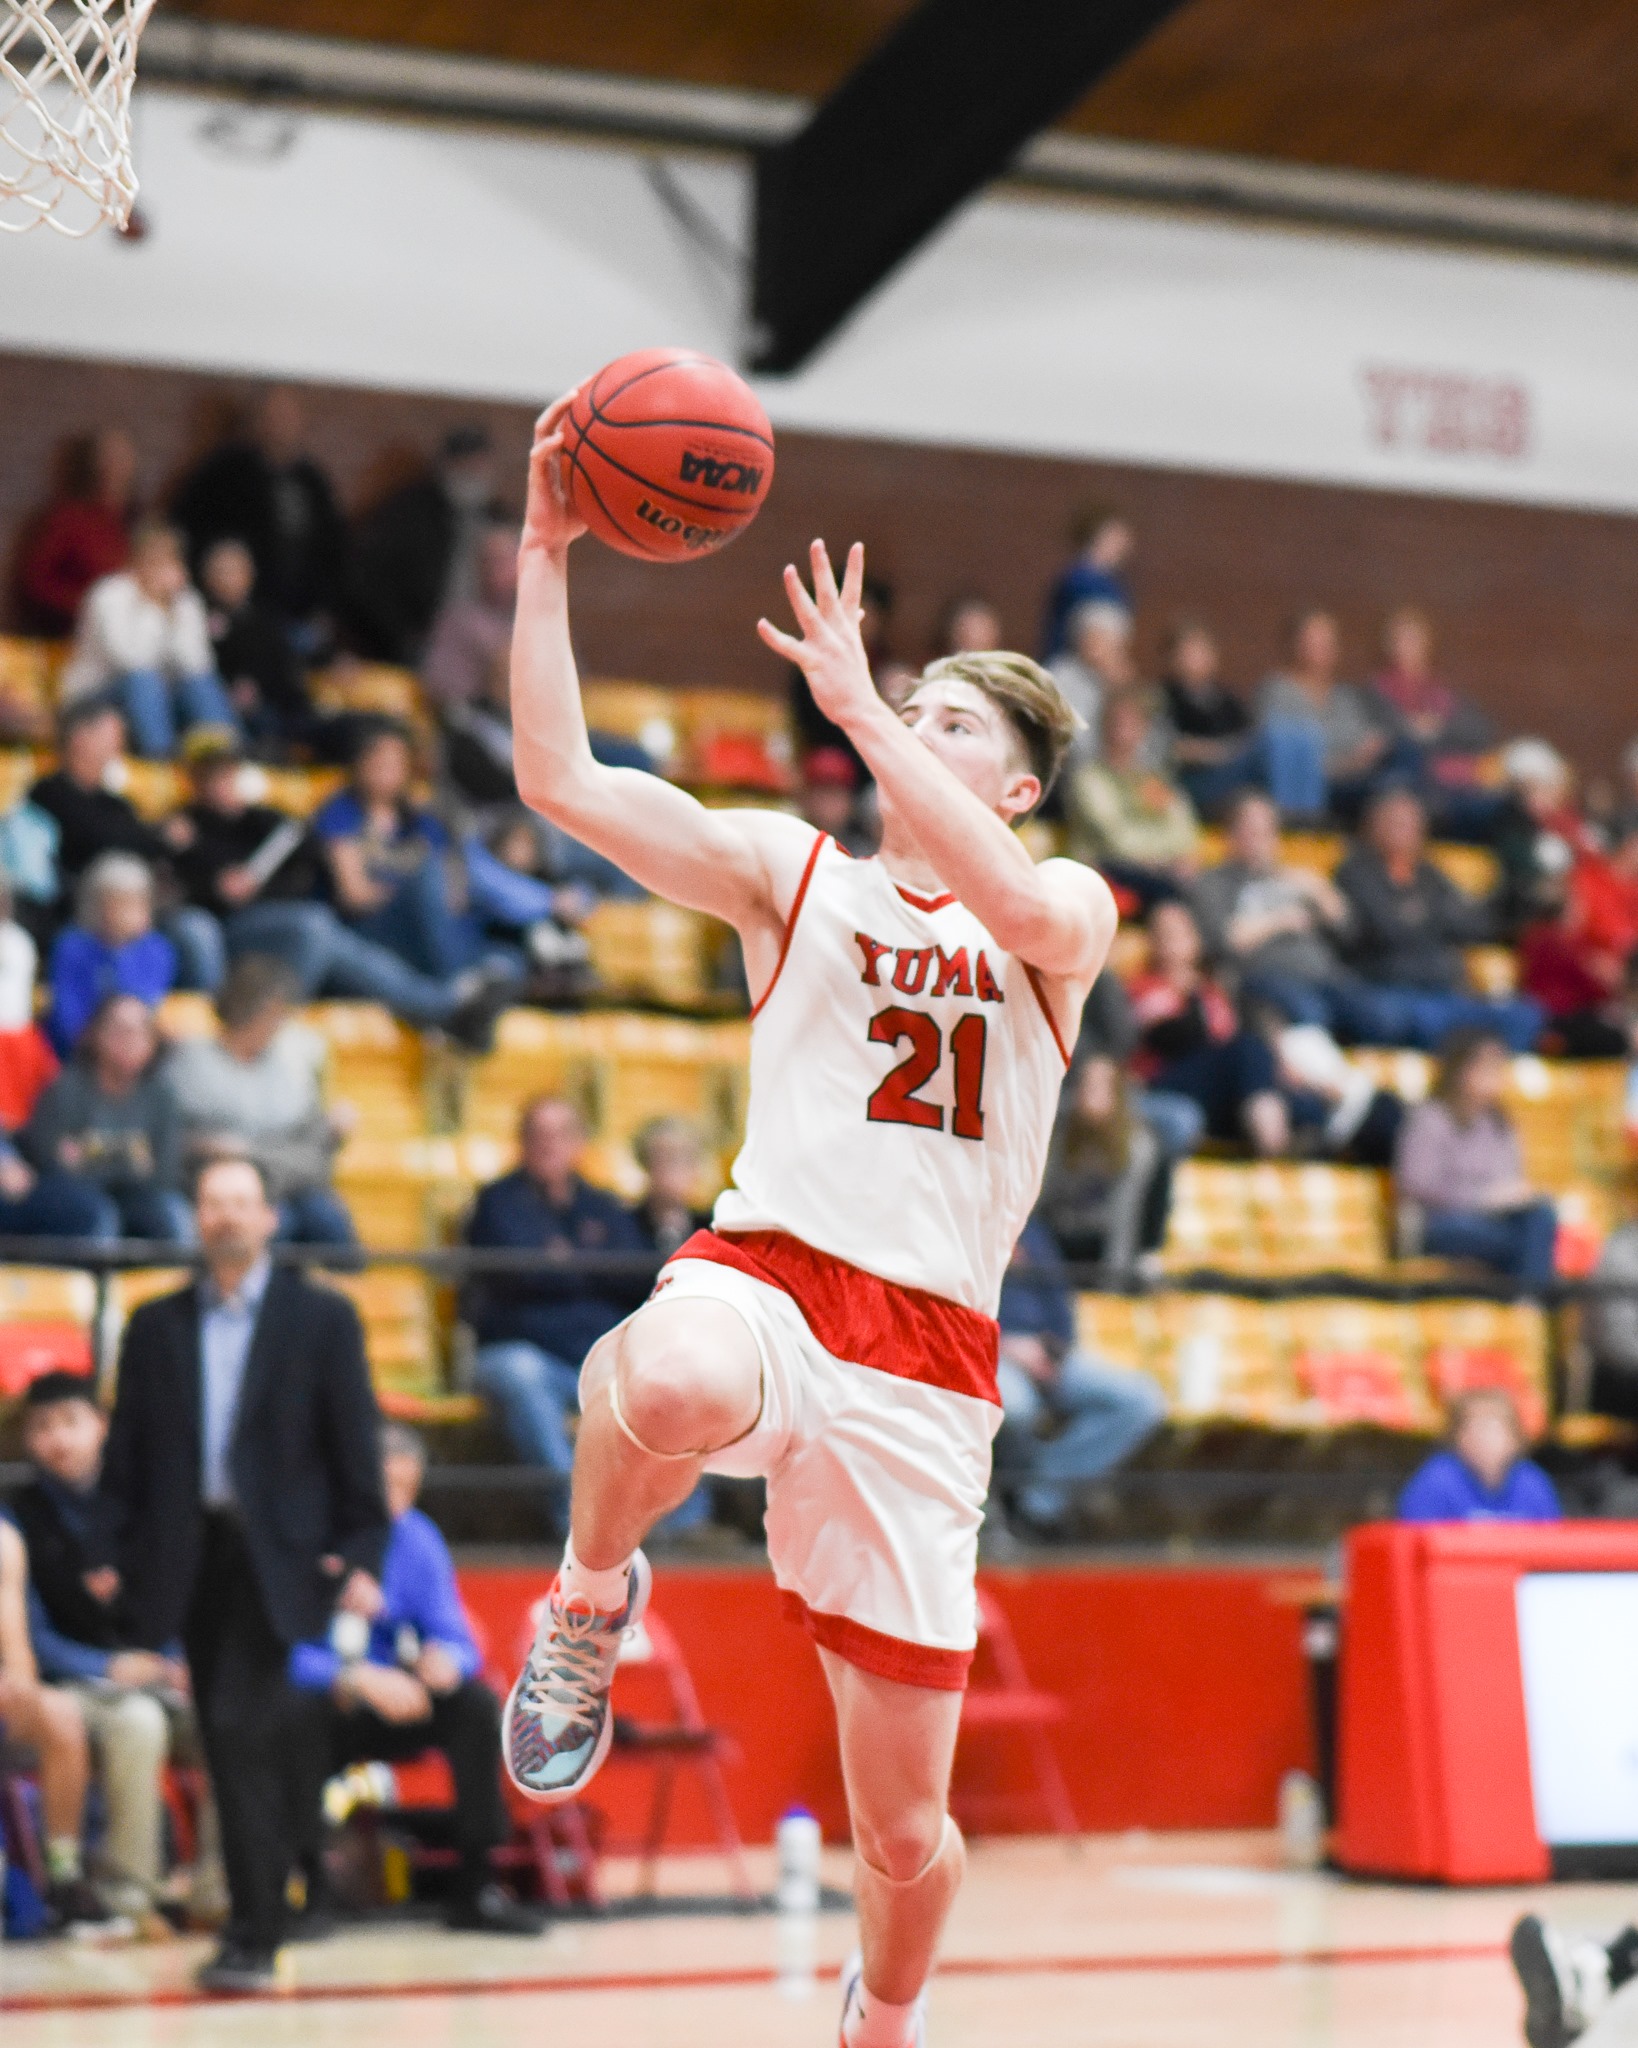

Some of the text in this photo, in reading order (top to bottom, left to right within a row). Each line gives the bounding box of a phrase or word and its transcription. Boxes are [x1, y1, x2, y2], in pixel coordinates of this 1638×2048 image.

[681, 451, 763, 494] NCAA
[855, 931, 1005, 1003] YUMA
[867, 1004, 987, 1141] 21
